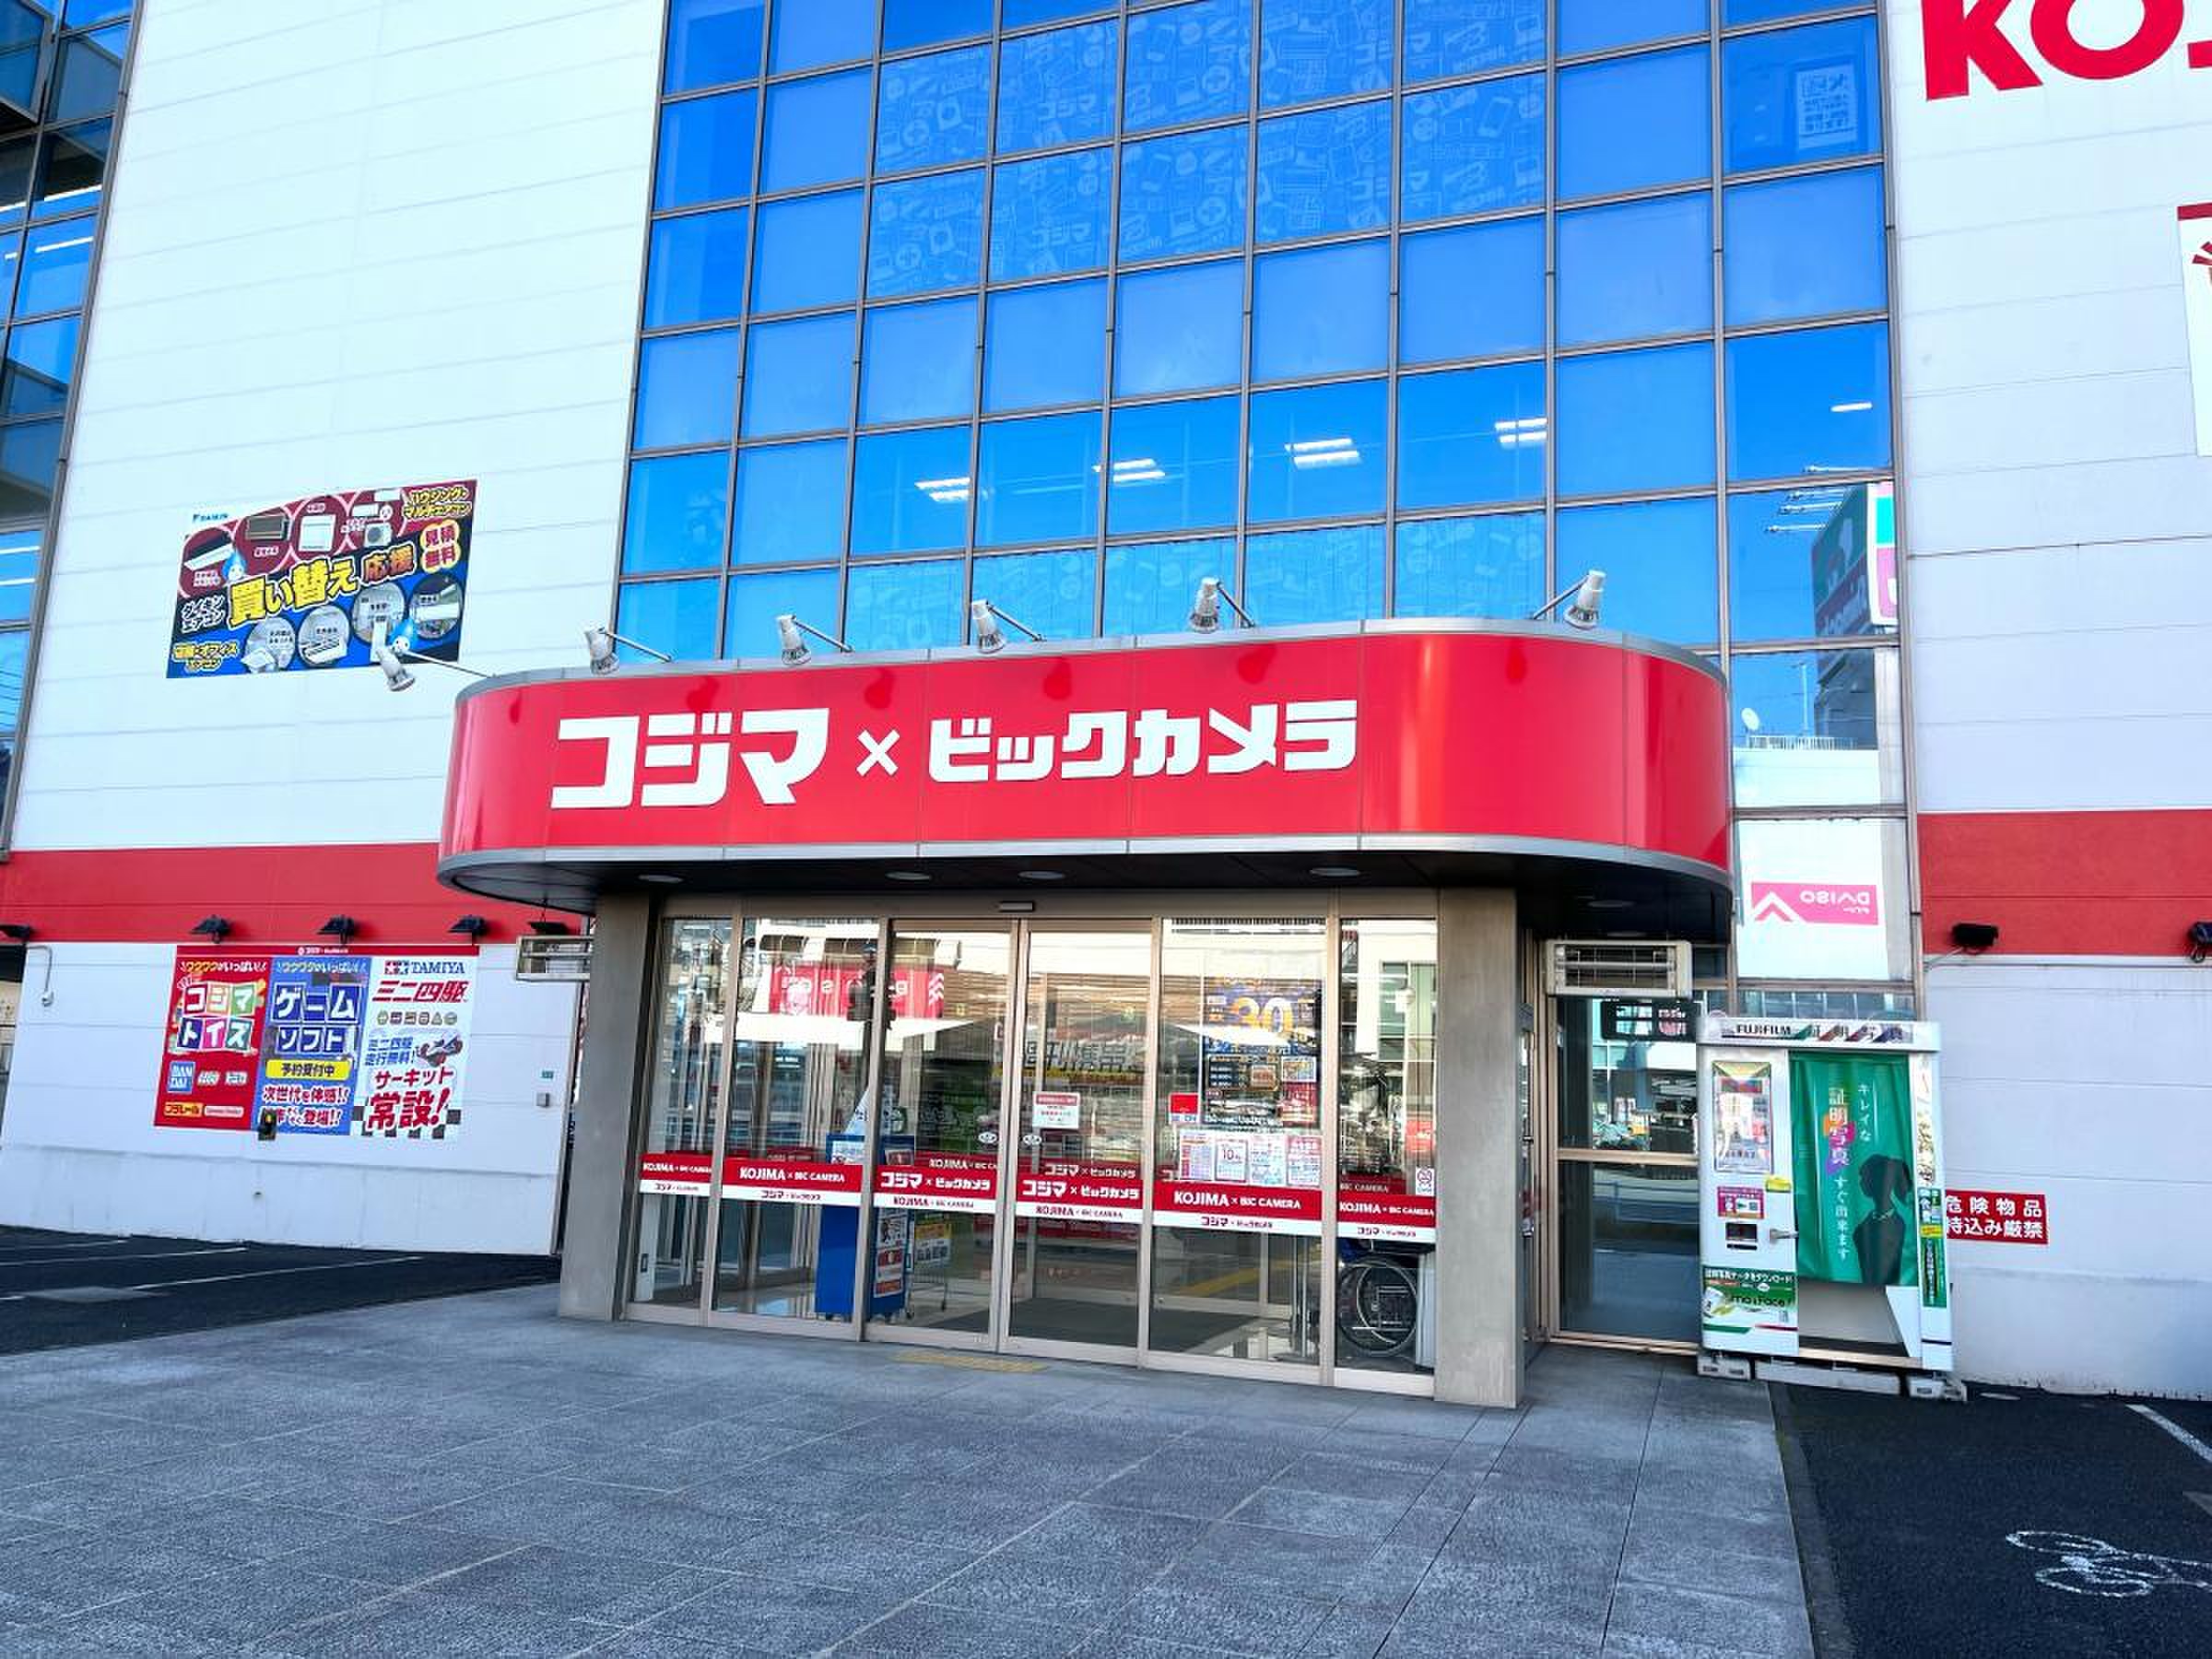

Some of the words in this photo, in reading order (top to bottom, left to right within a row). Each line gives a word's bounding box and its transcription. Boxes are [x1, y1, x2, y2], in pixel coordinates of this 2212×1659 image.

[1921, 0, 2212, 101] KO
[230, 559, 357, 627] 買い替え
[550, 707, 829, 808] コジマ
[929, 700, 1358, 782] ビックカメラ
[412, 961, 465, 974] TAMIYA
[187, 987, 253, 1012] コジマ
[276, 990, 355, 1019] ゲーム
[1736, 1024, 1792, 1035] FUJIFILM
[280, 1030, 345, 1051] ソフト
[374, 1067, 453, 1089] サーキット
[368, 1088, 451, 1129] 常設!
[739, 1167, 785, 1181] KOJIMA
[880, 1171, 923, 1189] コジマ
[1023, 1179, 1067, 1197] コジマ
[1174, 1191, 1230, 1206] KOJIMA
[1258, 1197, 1301, 1209] CAMERA
[1339, 1201, 1382, 1214] KOJIMA
